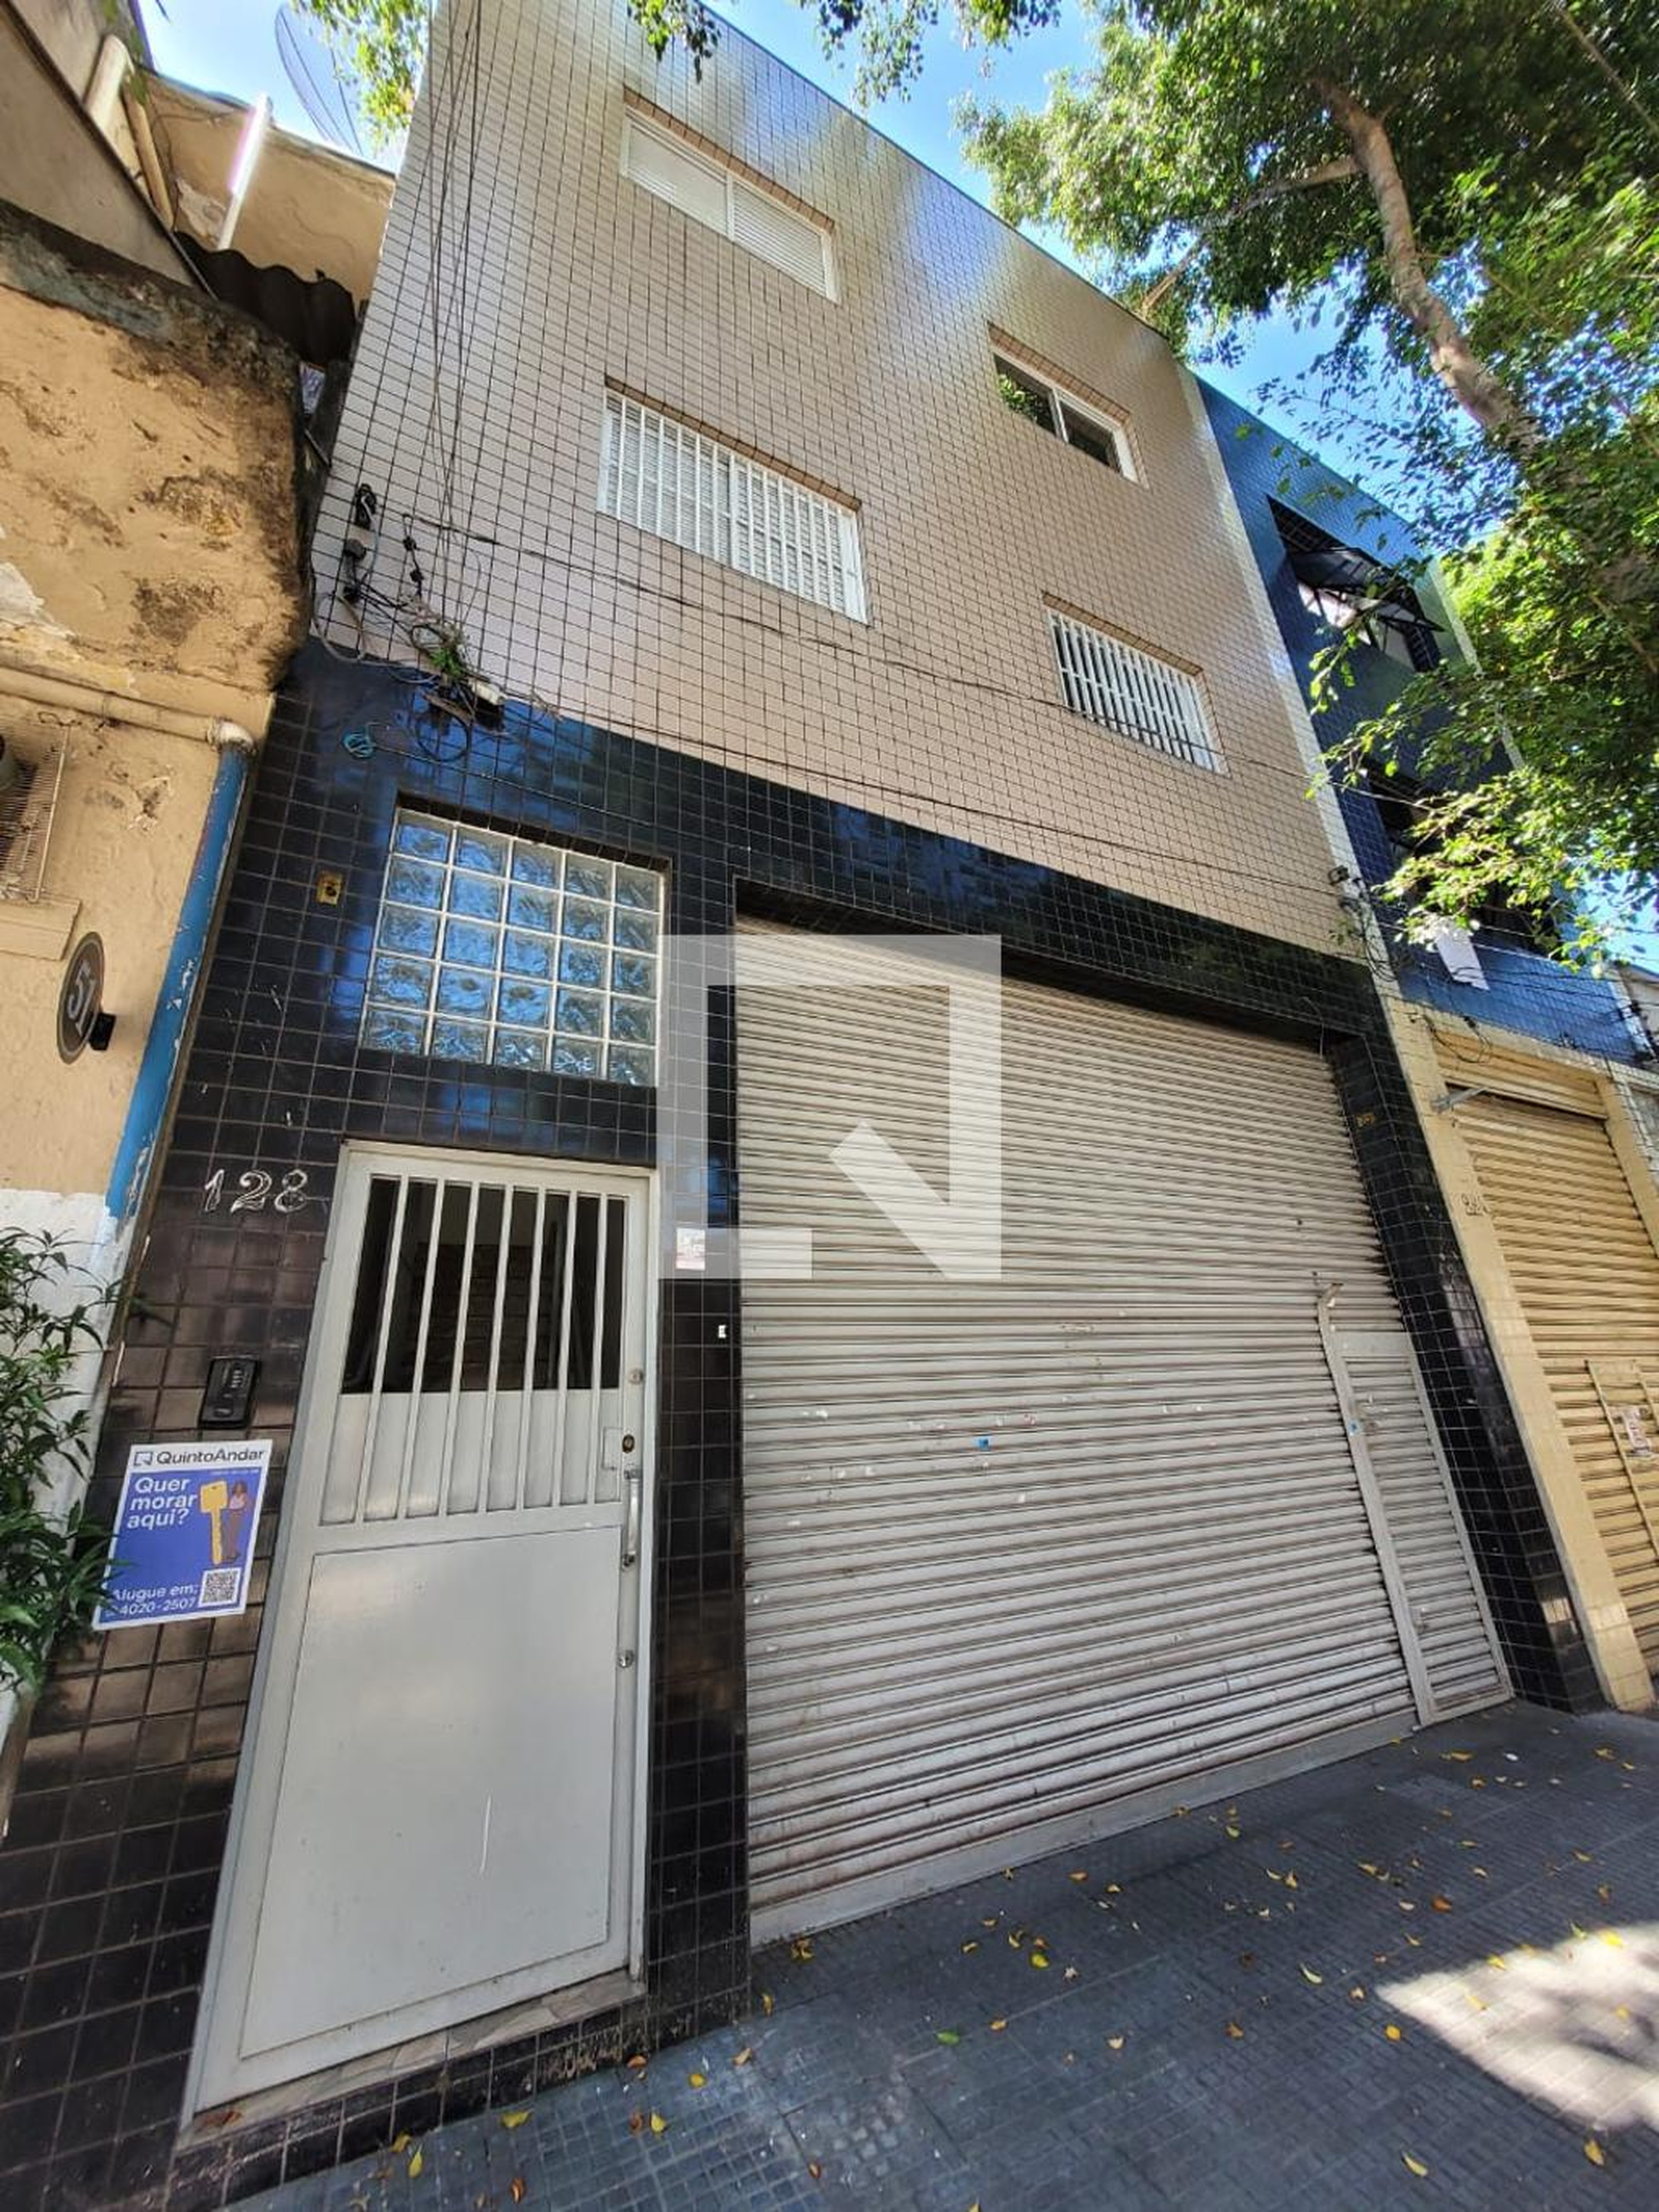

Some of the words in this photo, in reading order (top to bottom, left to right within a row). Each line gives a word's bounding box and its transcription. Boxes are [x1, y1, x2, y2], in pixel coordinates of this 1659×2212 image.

[204, 1168, 308, 1212] 128
[156, 1448, 266, 1464] QuintoAndar
[134, 1477, 190, 1493] Quer
[130, 1494, 197, 1511] morar
[127, 1509, 189, 1531] aqui?
